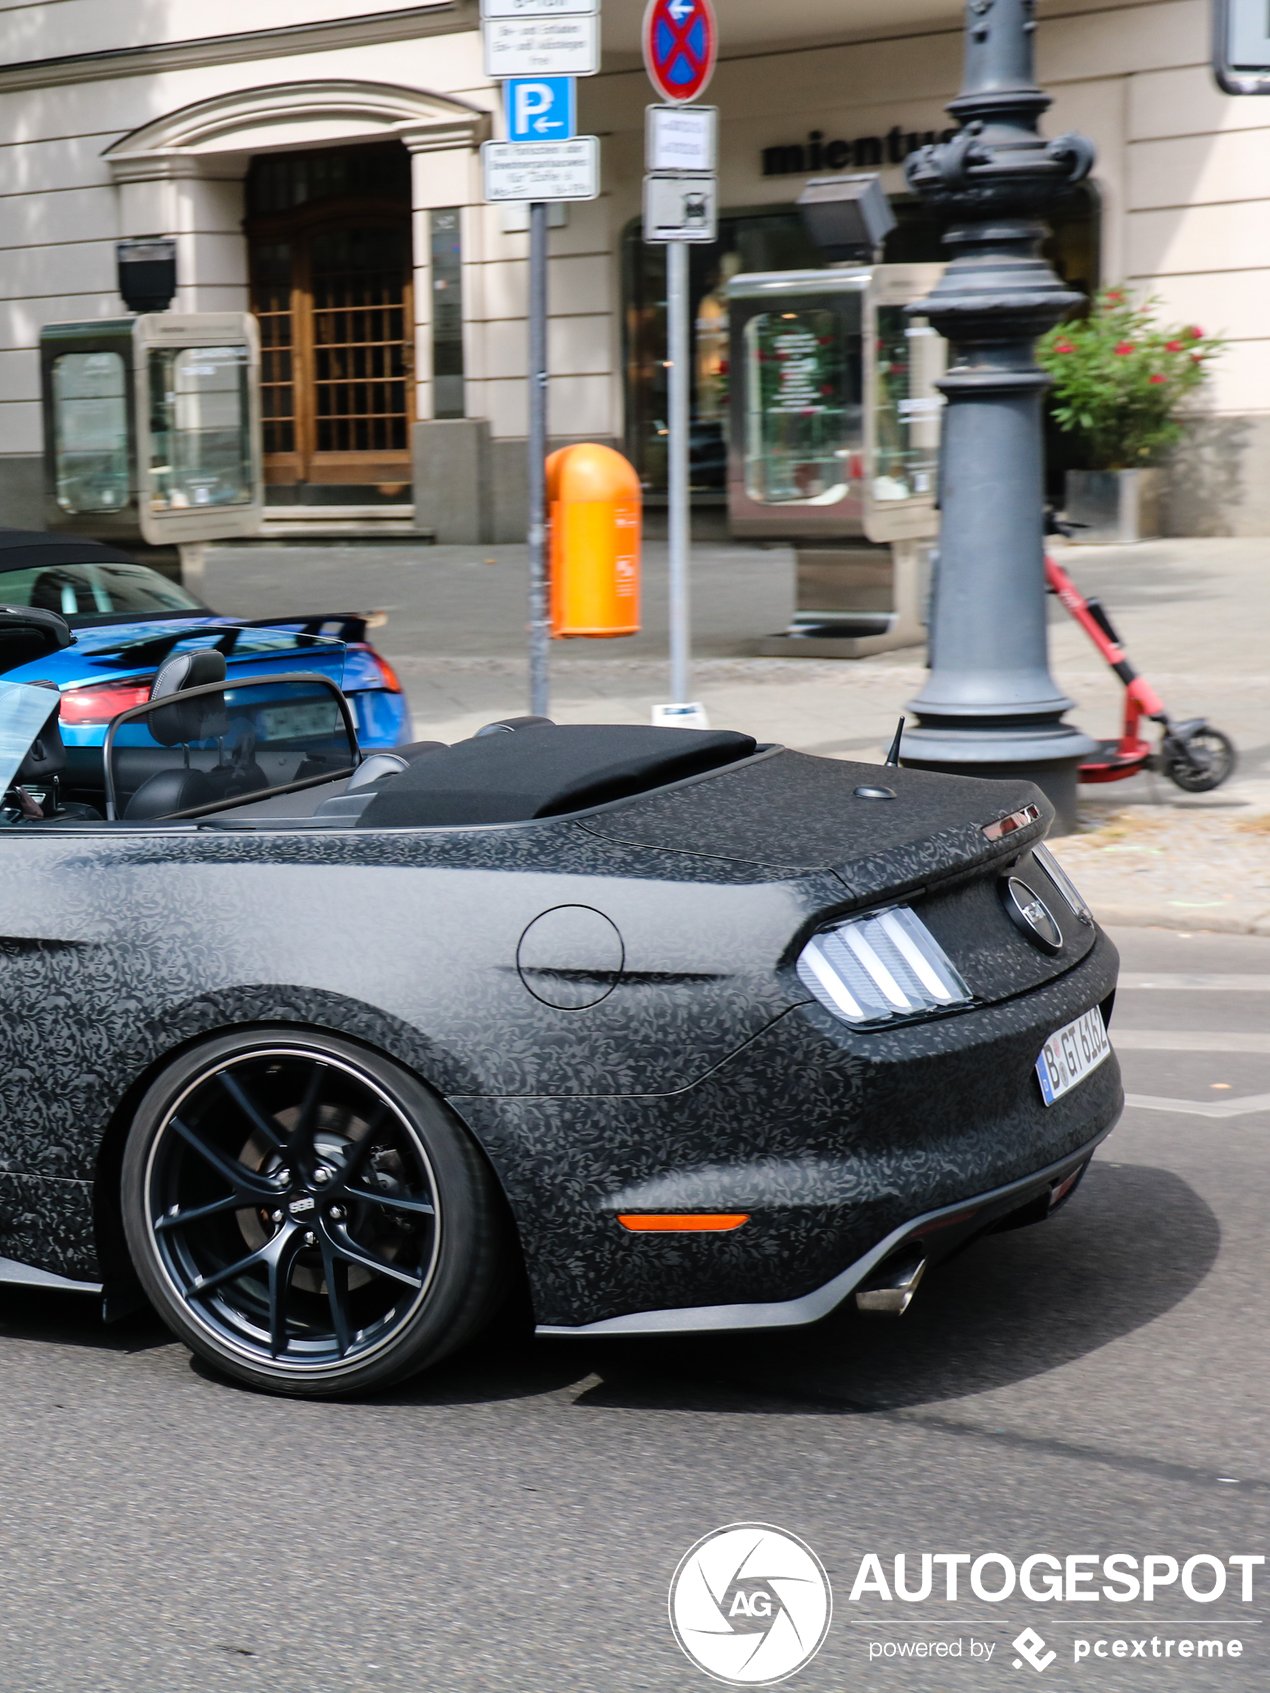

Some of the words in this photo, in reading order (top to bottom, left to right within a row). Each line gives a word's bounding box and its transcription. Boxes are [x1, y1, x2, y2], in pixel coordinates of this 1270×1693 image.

[515, 83, 555, 135] P
[1043, 1043, 1060, 1090] B
[1061, 1025, 1083, 1077] GT
